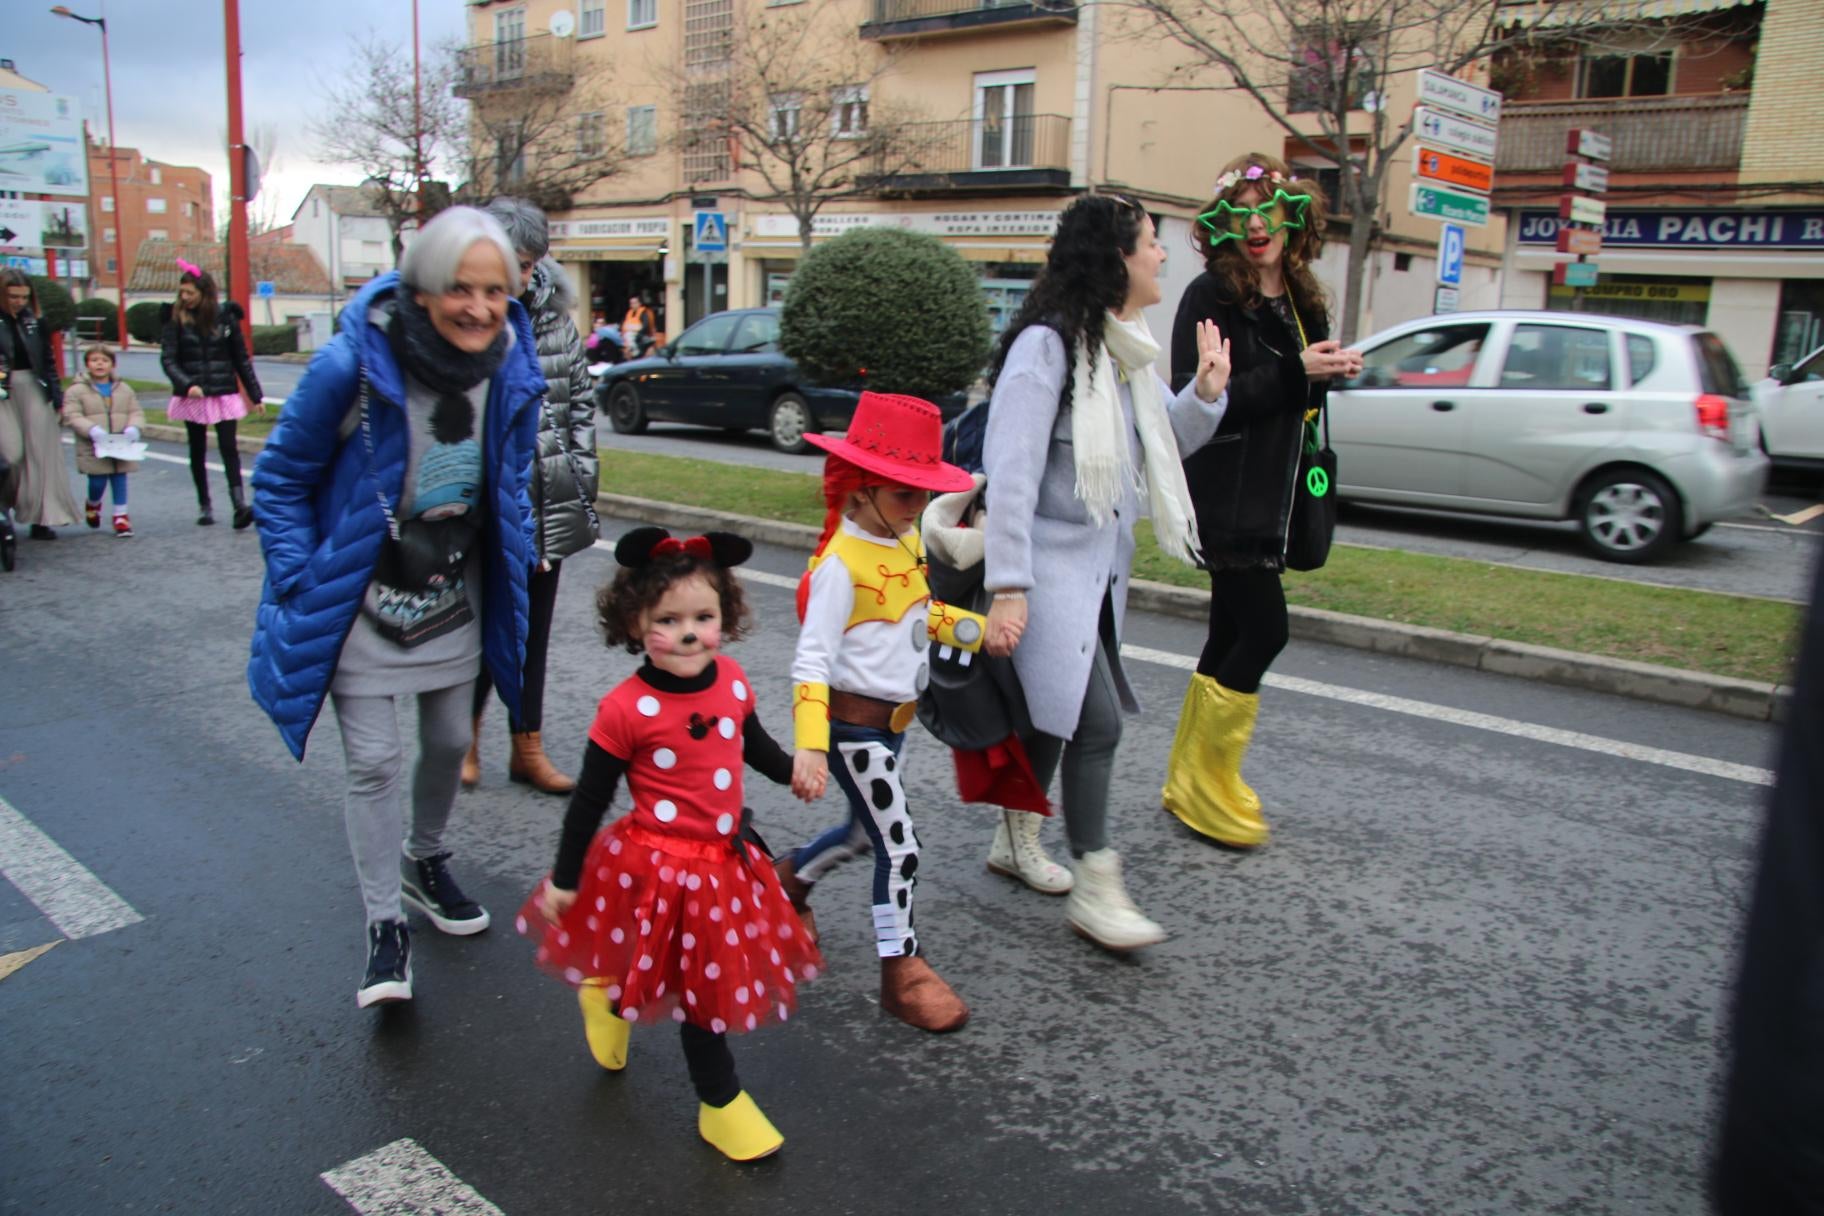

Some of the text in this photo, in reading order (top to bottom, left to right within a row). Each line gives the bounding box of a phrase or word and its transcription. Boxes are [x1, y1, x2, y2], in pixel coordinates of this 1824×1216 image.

[811, 216, 869, 224] ABALLERO
[934, 214, 977, 222] HOGAR
[578, 222, 631, 234] FABRICACION
[636, 221, 668, 232] PROPIA
[948, 225, 981, 233] ROPA
[1657, 215, 1784, 242] PACHI
[1444, 230, 1460, 278] P
[1583, 284, 1680, 298] COMPRO ORO
